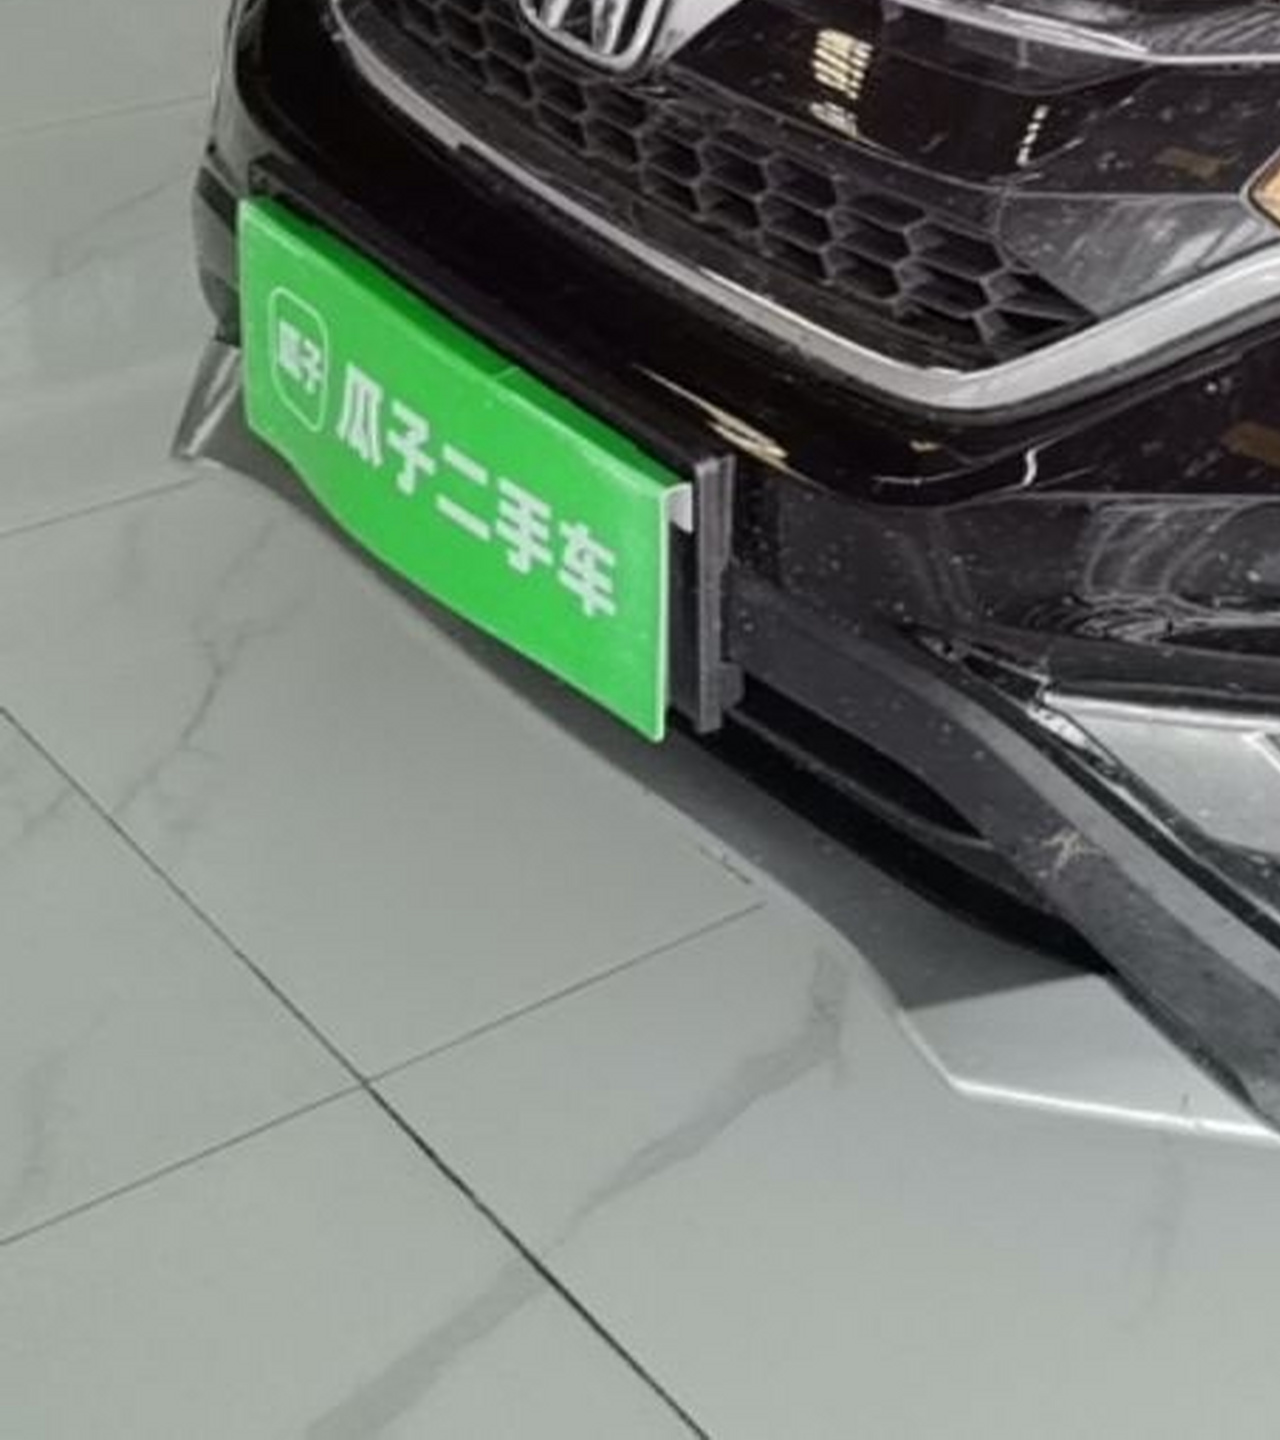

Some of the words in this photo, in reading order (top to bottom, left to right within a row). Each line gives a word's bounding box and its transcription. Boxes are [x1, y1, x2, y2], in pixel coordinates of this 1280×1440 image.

[335, 360, 617, 618] 瓜子二手车
